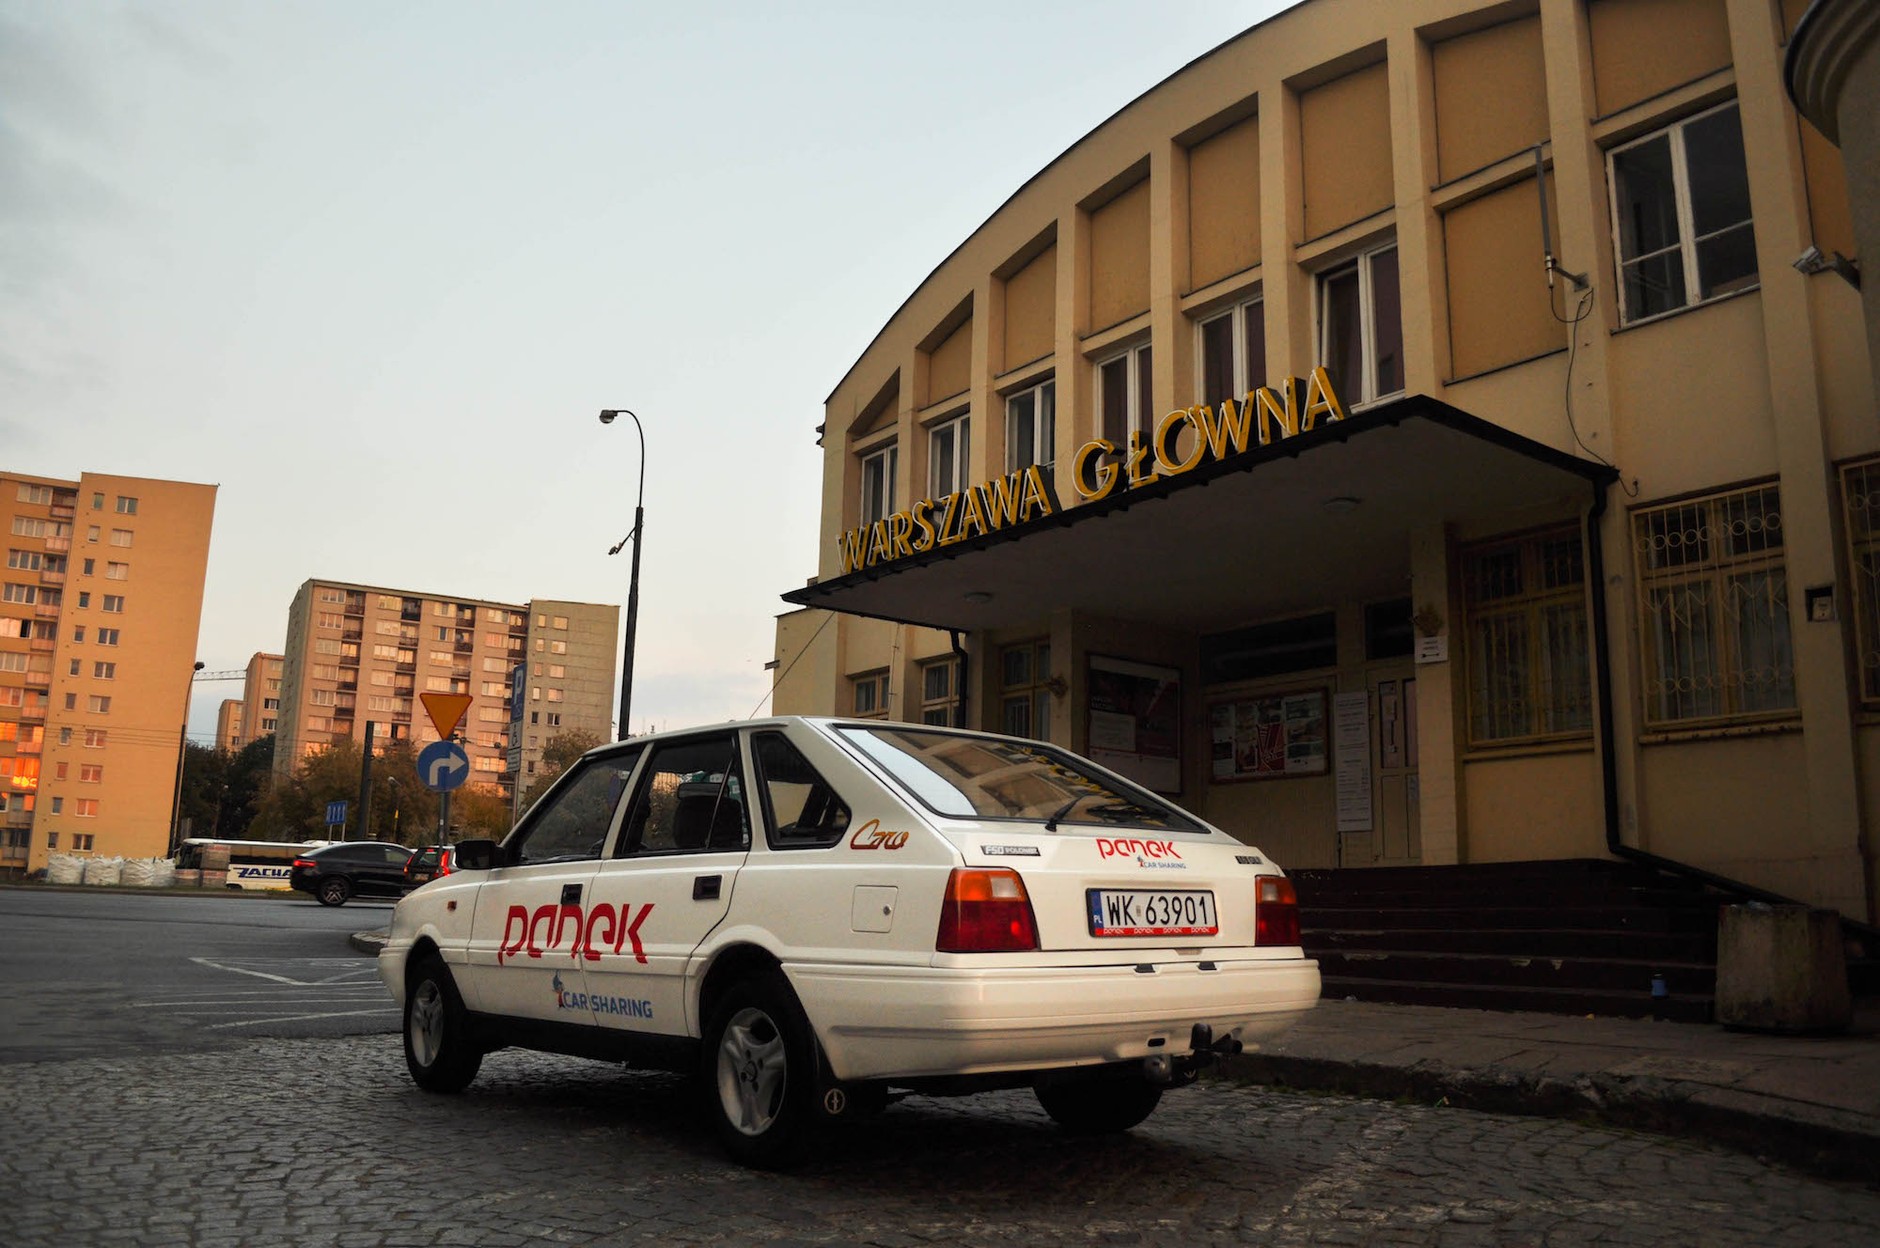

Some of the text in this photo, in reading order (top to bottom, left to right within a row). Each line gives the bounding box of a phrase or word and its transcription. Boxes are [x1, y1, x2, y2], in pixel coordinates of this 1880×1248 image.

[835, 463, 1054, 574] WARSZAWA
[513, 669, 524, 705] P
[1143, 861, 1187, 869] CAR SHARING
[1106, 895, 1208, 926] WK 63901
[563, 991, 653, 1018] CAR SHARING
